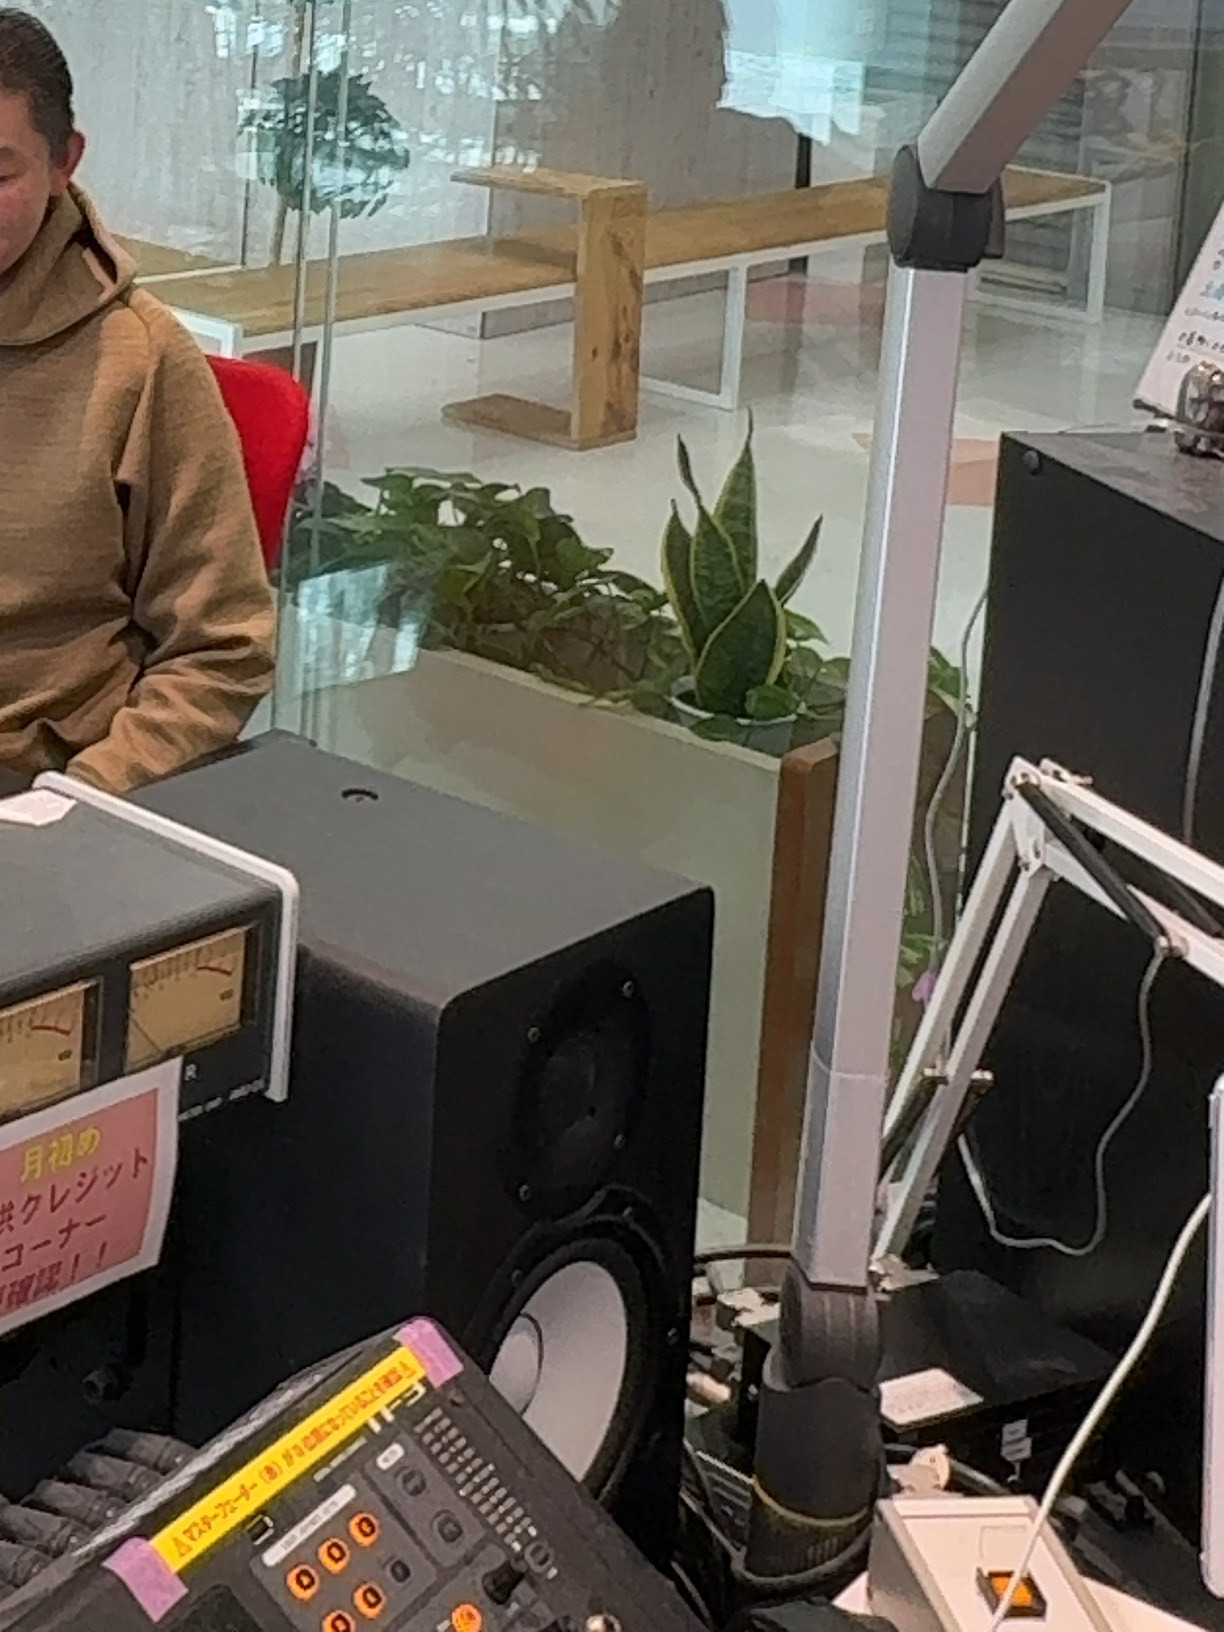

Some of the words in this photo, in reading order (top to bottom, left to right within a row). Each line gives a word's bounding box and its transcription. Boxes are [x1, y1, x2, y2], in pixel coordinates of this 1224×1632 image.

[21, 1126, 101, 1184] 月初め
[1, 1214, 108, 1272] コーナー
